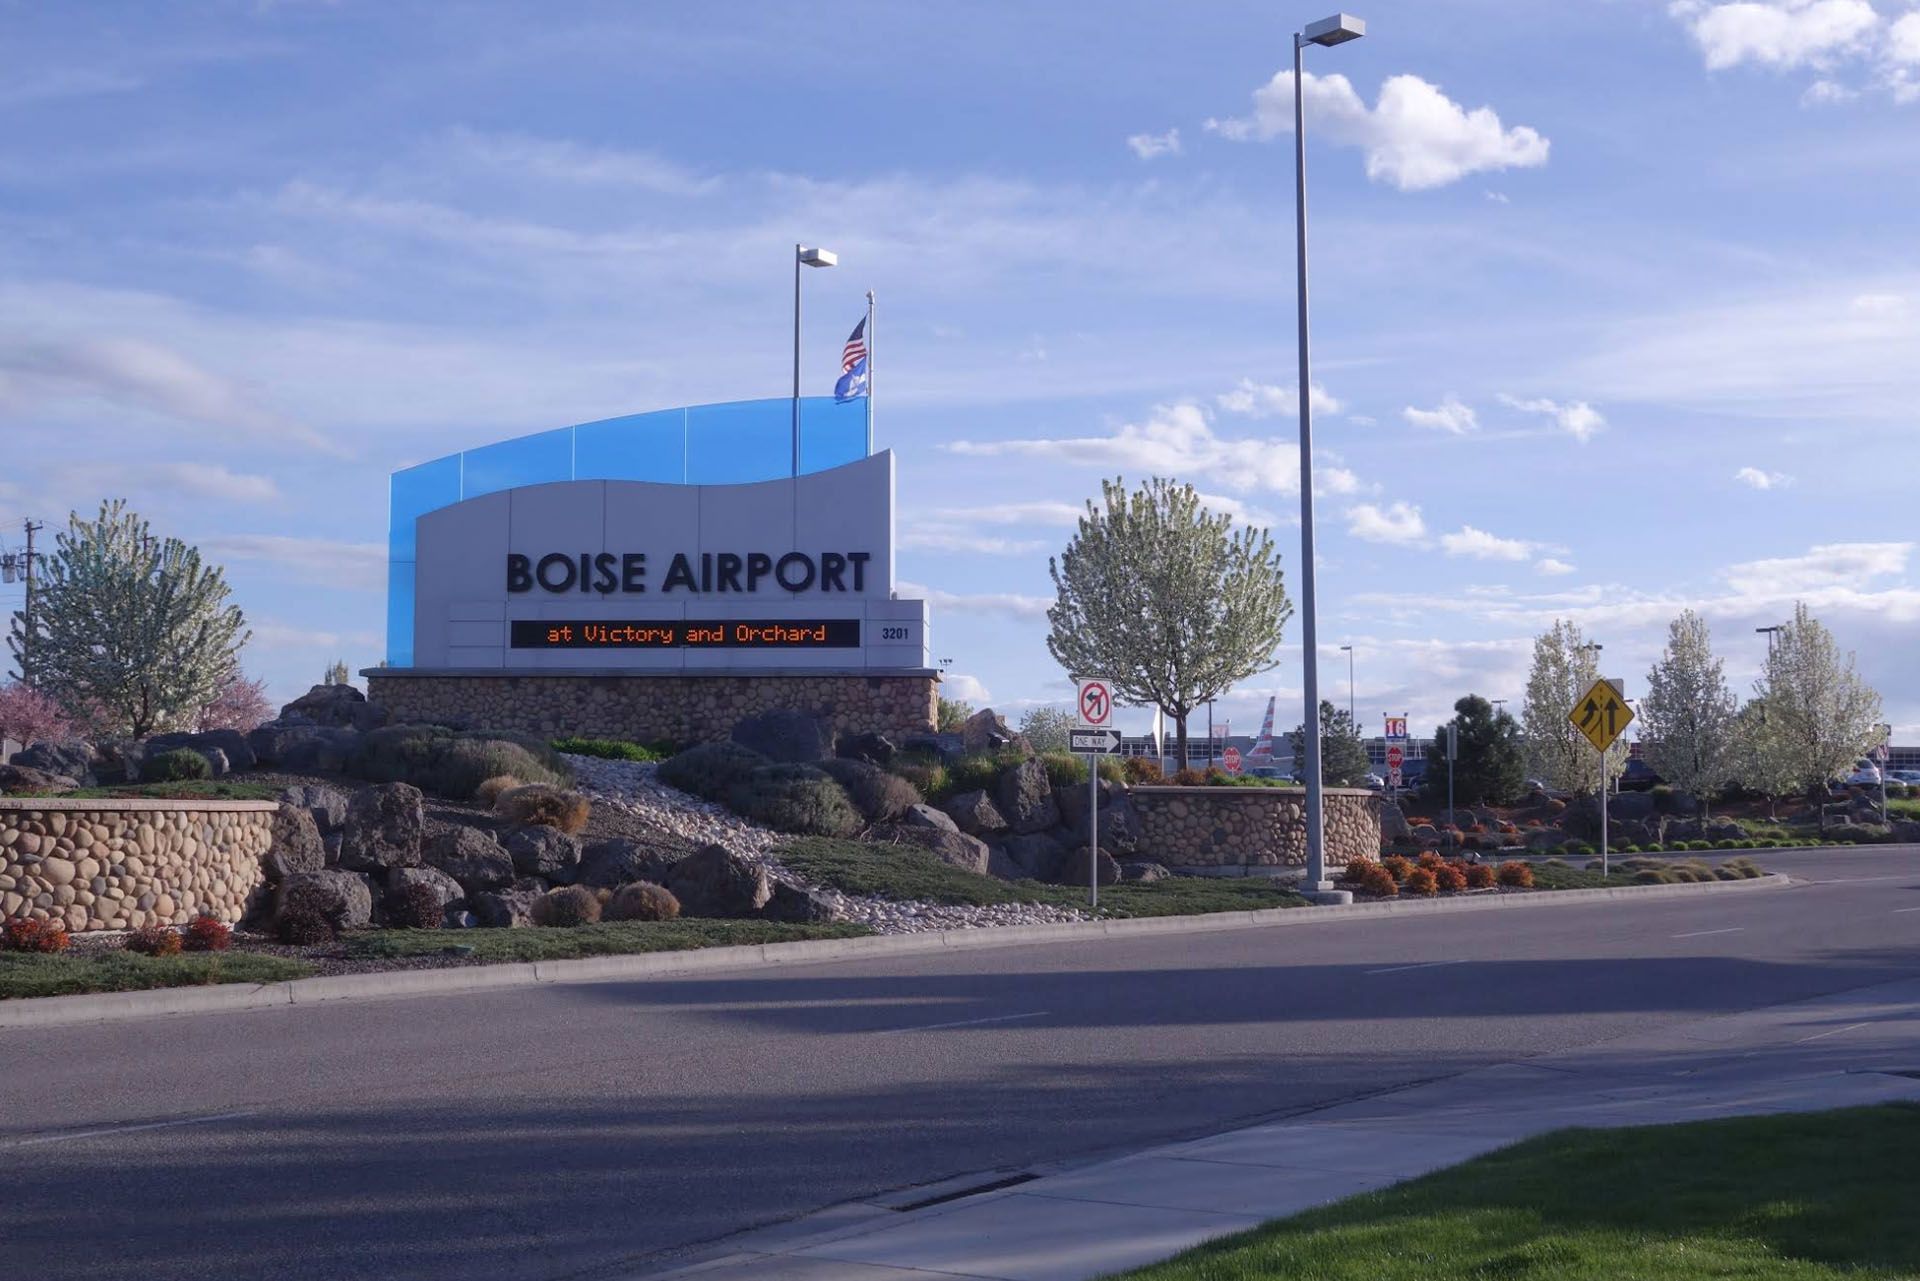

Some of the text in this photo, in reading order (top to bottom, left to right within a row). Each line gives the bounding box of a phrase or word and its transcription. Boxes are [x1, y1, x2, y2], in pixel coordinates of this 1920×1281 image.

[507, 552, 870, 593] BOISE AIRPORT
[547, 625, 826, 643] at Victory and Orchard
[882, 628, 909, 640] 3201
[1387, 720, 1404, 737] 16
[1075, 736, 1105, 746] ONE WAY
[1225, 755, 1239, 764] STOP
